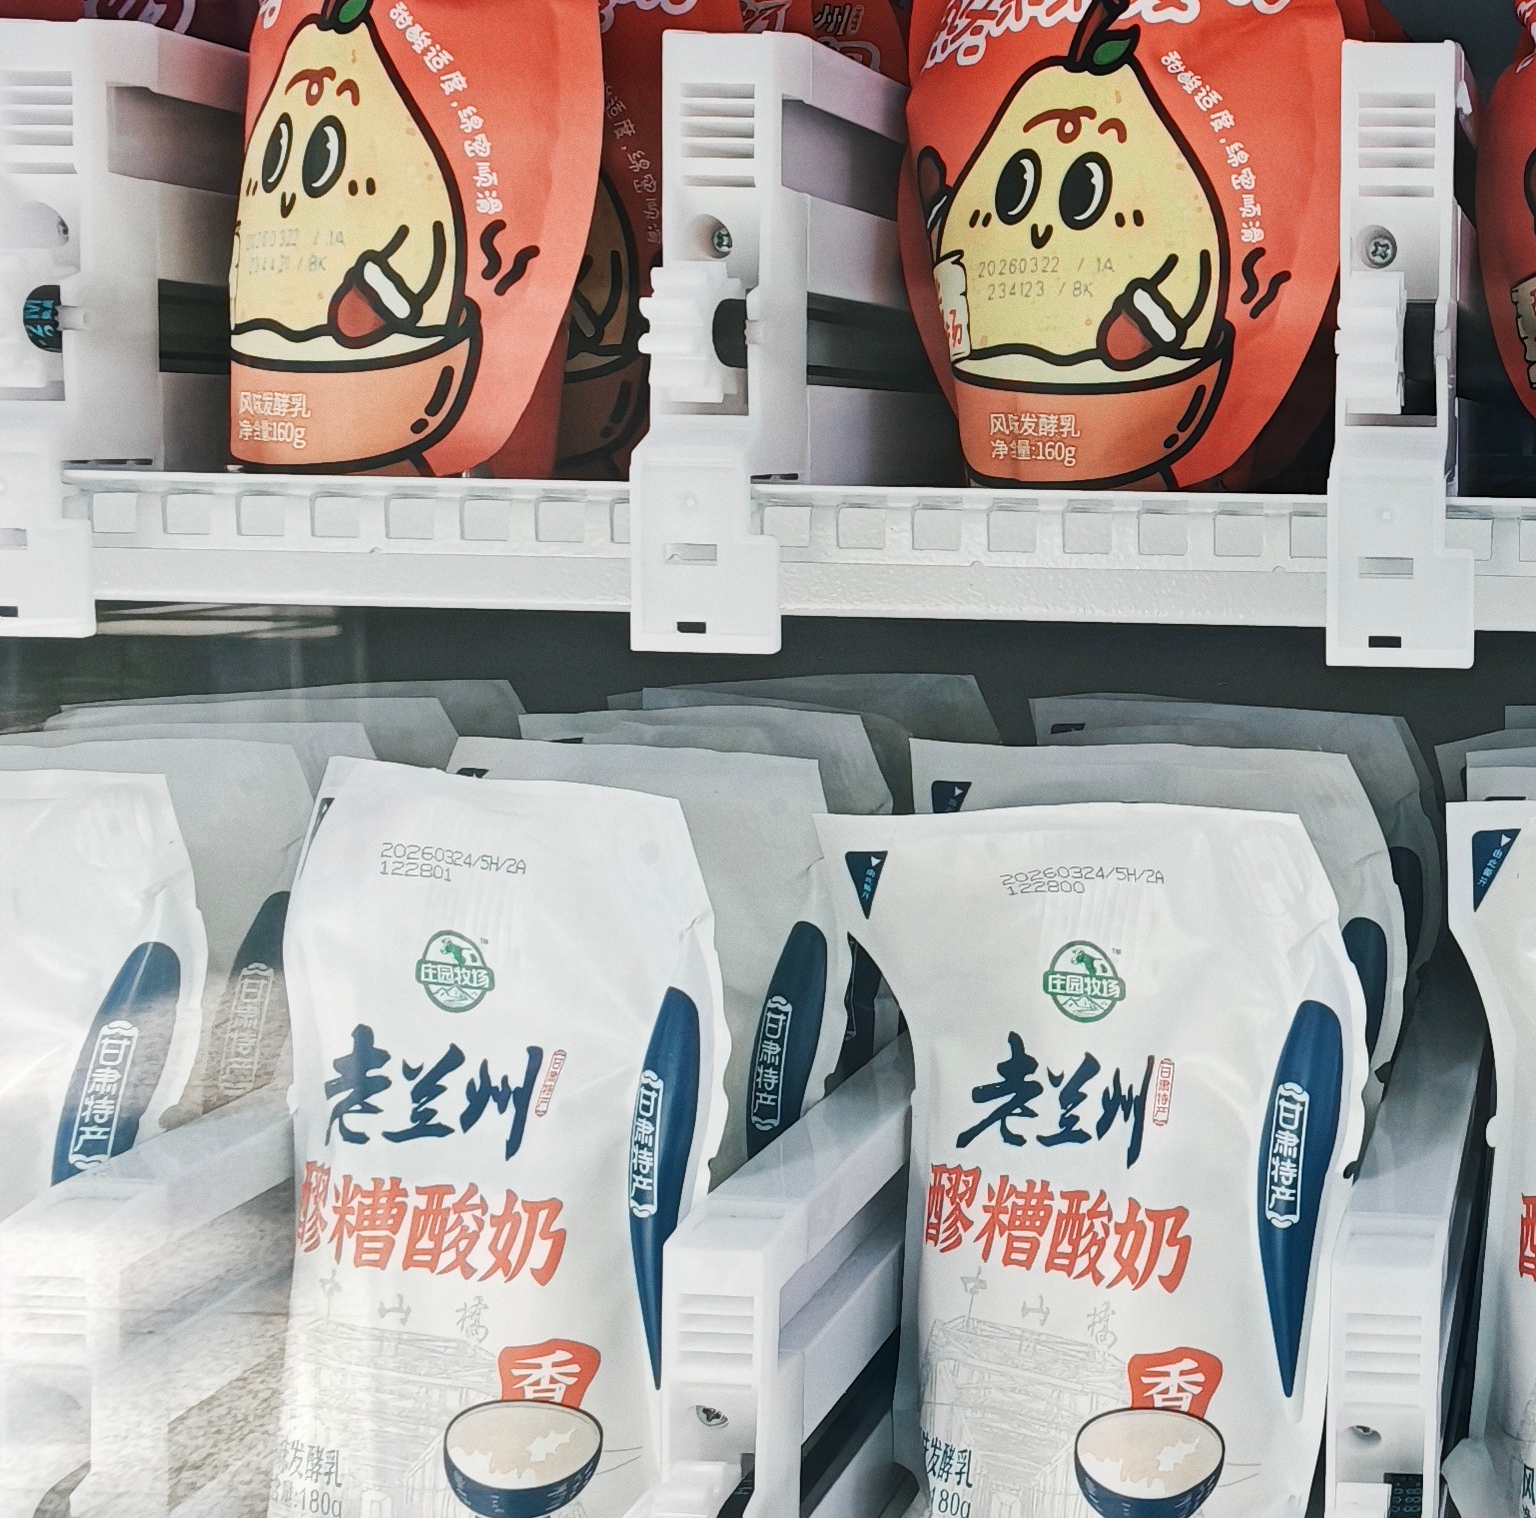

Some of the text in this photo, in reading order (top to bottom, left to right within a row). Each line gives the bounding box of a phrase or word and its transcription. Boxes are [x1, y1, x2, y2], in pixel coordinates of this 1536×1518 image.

[977, 256, 1116, 279] 20260322 1A
[987, 280, 1094, 301] 234123 8K
[379, 860, 453, 883] 122801
[380, 841, 527, 876] 20260324/5H/2A
[1000, 866, 1165, 886] 20260324/5H/2A
[1007, 880, 1086, 896] 122800
[420, 962, 490, 989] 庄园牧场
[1048, 973, 1121, 1000] 庄园牧场
[756, 1007, 788, 1110] 甘肃特产
[74, 1033, 133, 1159] 甘肃特产
[324, 1023, 544, 1161] 老兰州
[955, 1030, 1155, 1169] 老兰州
[633, 1079, 659, 1196] 甘肃特产
[1269, 1097, 1303, 1209] 甘肃特产
[925, 1163, 1193, 1294] 醪糟酸奶
[509, 1349, 583, 1402] 香
[1140, 1357, 1206, 1412] 香
